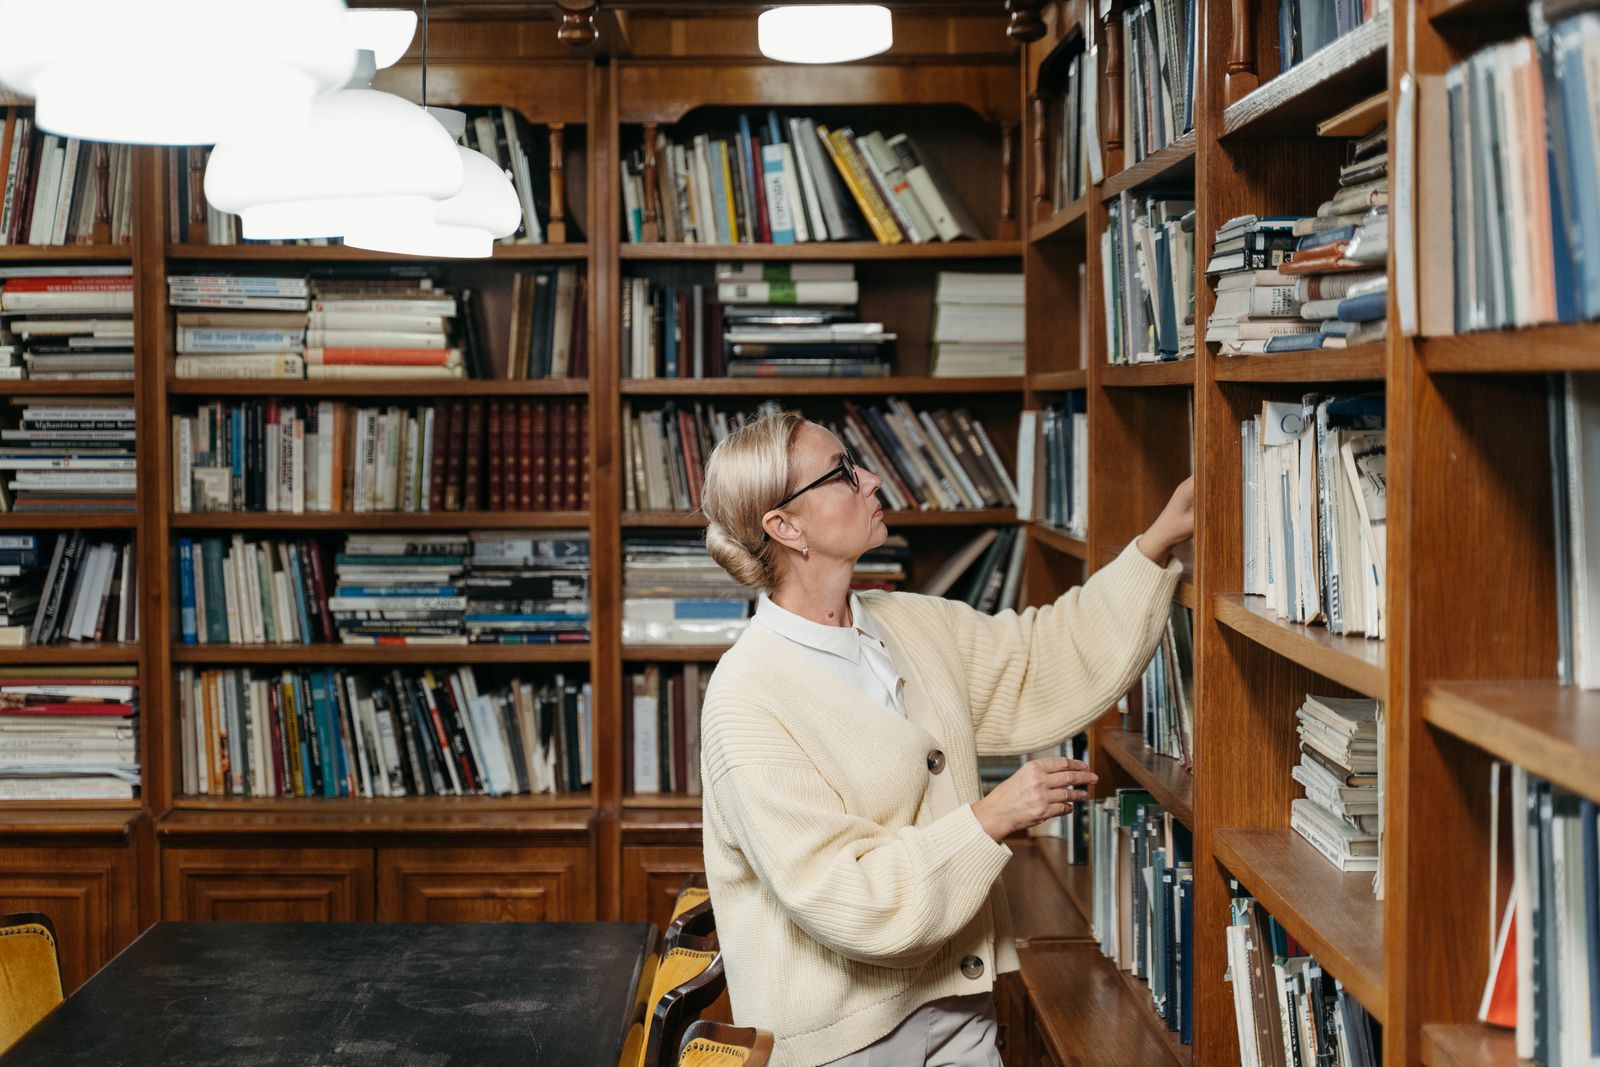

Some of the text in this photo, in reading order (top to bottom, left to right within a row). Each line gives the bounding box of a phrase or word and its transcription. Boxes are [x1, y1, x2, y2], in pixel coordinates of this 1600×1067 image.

[34, 421, 78, 430] Afghanistan
[80, 420, 94, 429] und
[96, 421, 115, 429] seine
